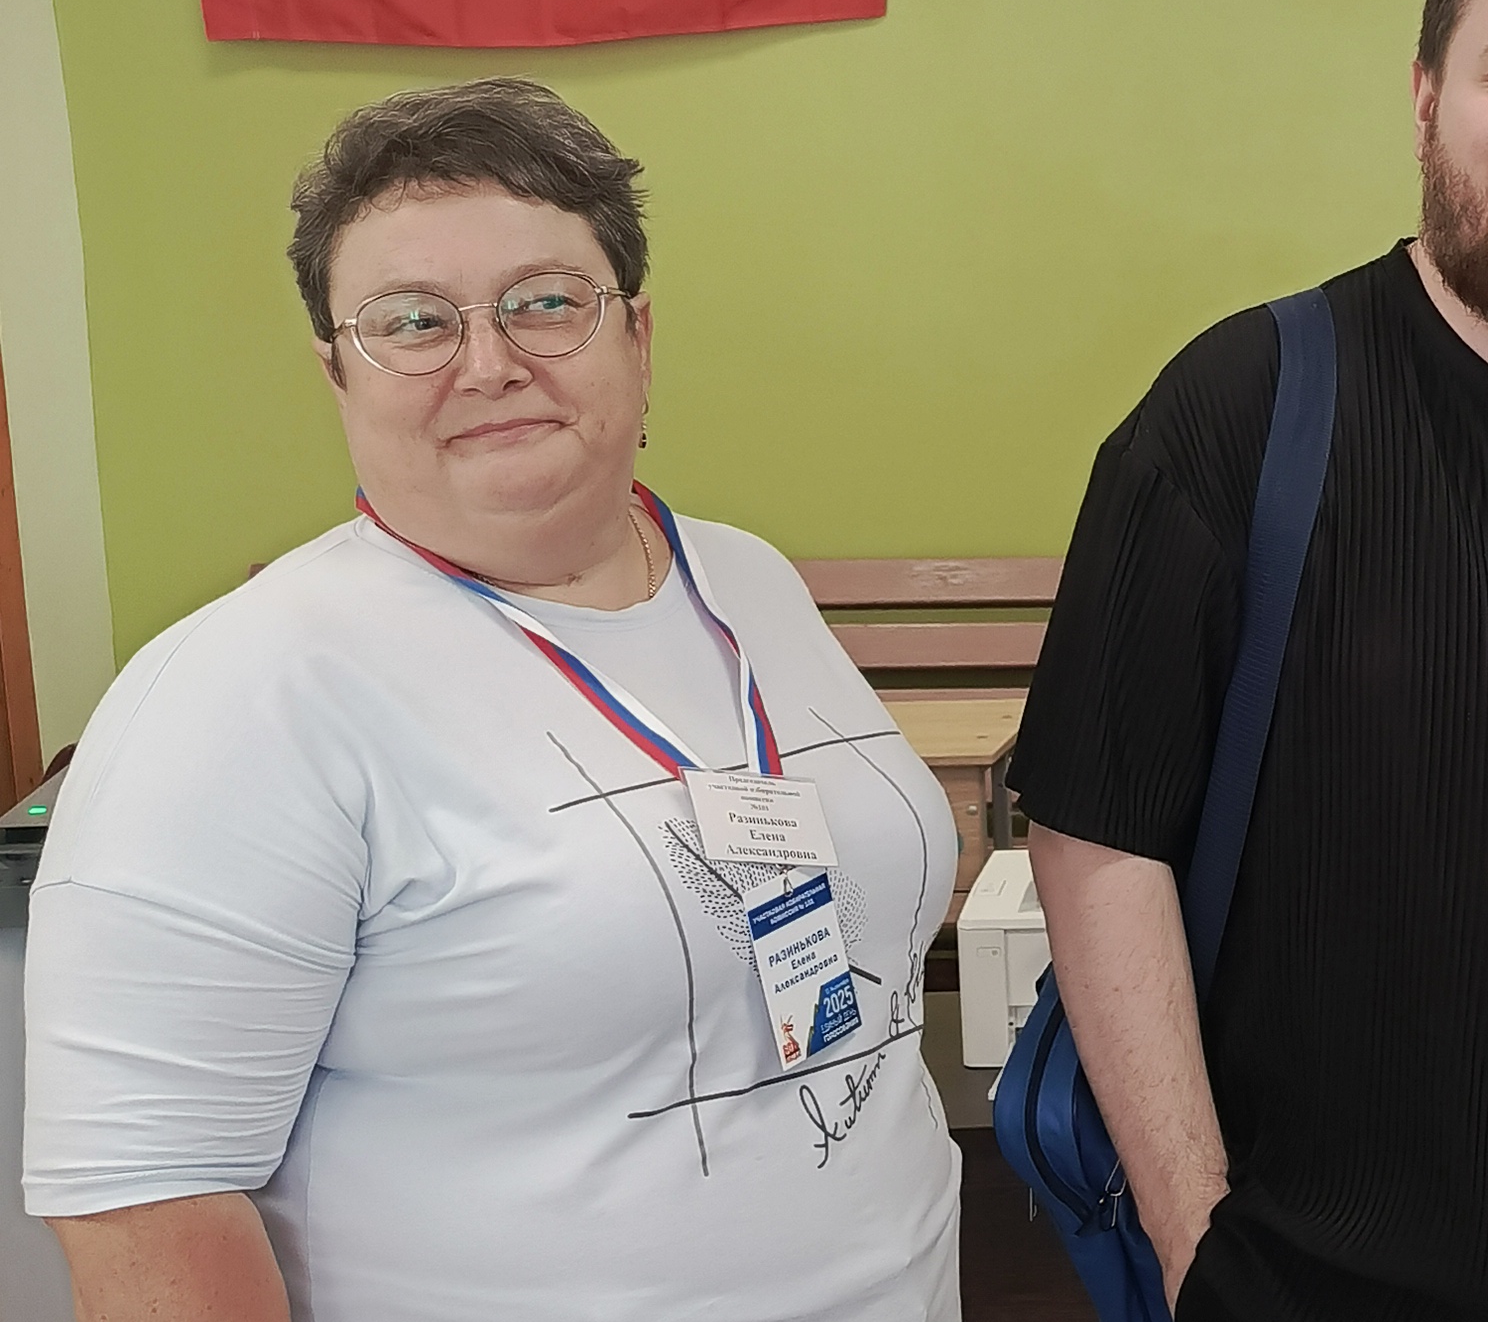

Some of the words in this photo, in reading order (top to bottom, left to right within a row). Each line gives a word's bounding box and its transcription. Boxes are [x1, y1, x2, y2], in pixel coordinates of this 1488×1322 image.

[728, 812, 798, 828] Разинькова
[749, 829, 787, 843] Елена
[727, 844, 818, 860] Александровна
[752, 902, 786, 925] УЧАСТКОВАЯ
[785, 882, 827, 907] ИЗБИРАТЕЛЬНАЯ
[770, 905, 799, 925] КОМИССИЯ
[768, 927, 831, 968] РАЗИНЬКОВА
[790, 951, 817, 971] Елена
[774, 953, 839, 994] Александровна
[823, 985, 854, 1018] 2025
[820, 1013, 843, 1035] ЕДИНЫЙ
[843, 1007, 857, 1022] ДЕНЬ
